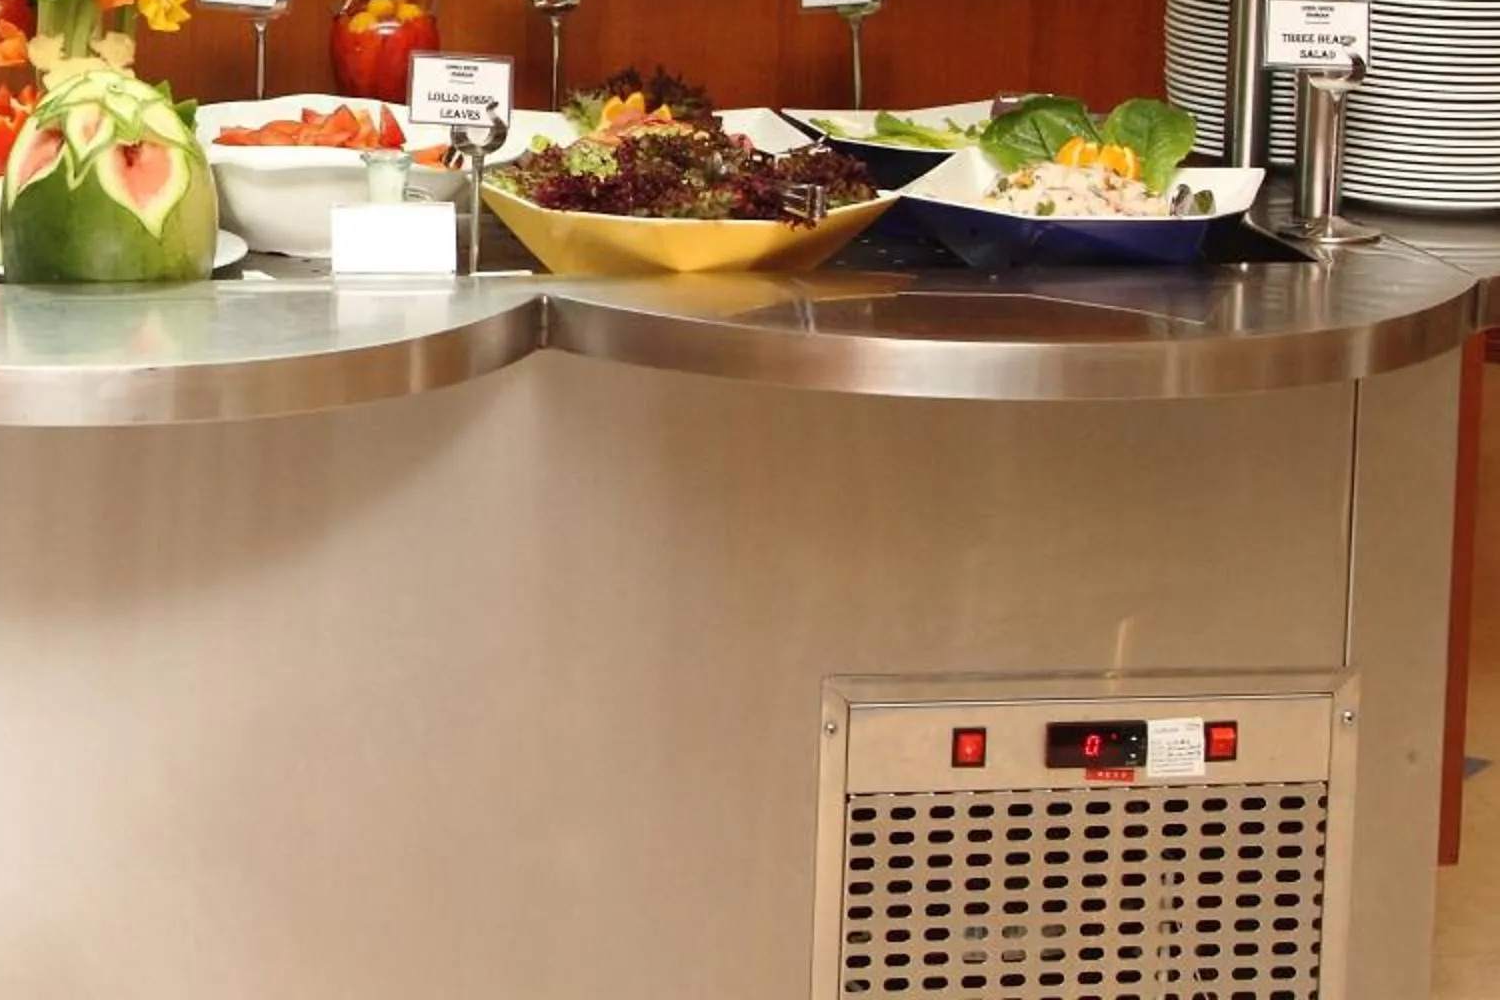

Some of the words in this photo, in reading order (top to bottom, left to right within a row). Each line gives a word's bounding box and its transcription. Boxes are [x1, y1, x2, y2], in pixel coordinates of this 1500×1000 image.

[1300, 49, 1337, 60] SALAD
[428, 91, 460, 103] LOLLO
[440, 108, 481, 120] LEAVES
